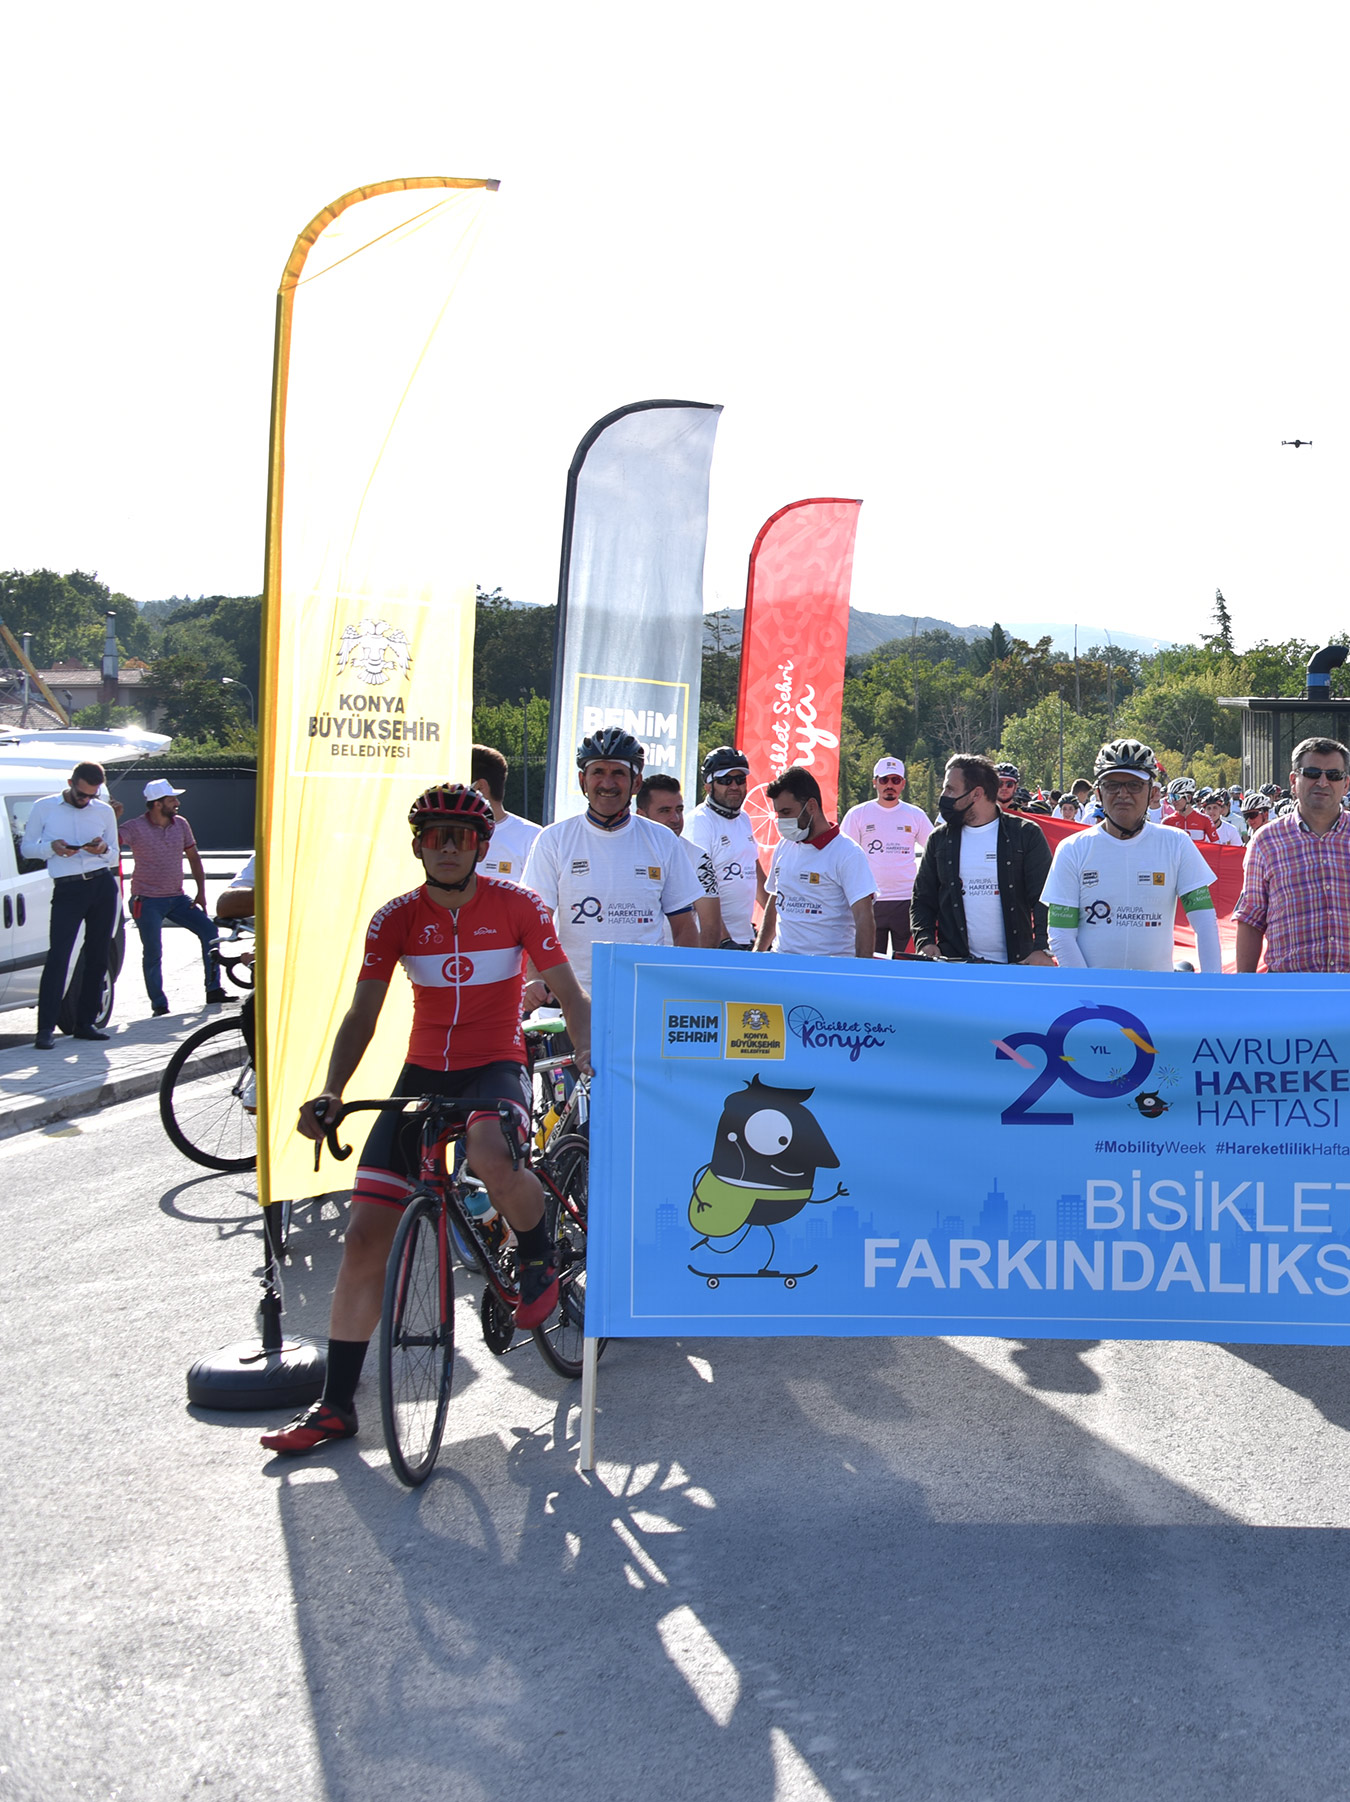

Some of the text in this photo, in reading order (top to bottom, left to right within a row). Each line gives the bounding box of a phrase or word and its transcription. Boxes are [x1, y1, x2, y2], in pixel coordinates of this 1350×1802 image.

[339, 694, 405, 713] KONYA
[308, 712, 440, 743] BÜYÜKŞEHİR
[331, 743, 411, 758] BELEDİYESİ
[815, 1020, 896, 1034] Bisiklet Şehri
[802, 1023, 885, 1062] Konya
[1089, 1045, 1111, 1056] YIL
[1191, 1038, 1338, 1065] AVRUPA
[1197, 1098, 1339, 1128] HAFTASI
[1094, 1140, 1206, 1156] #MobilityWeek
